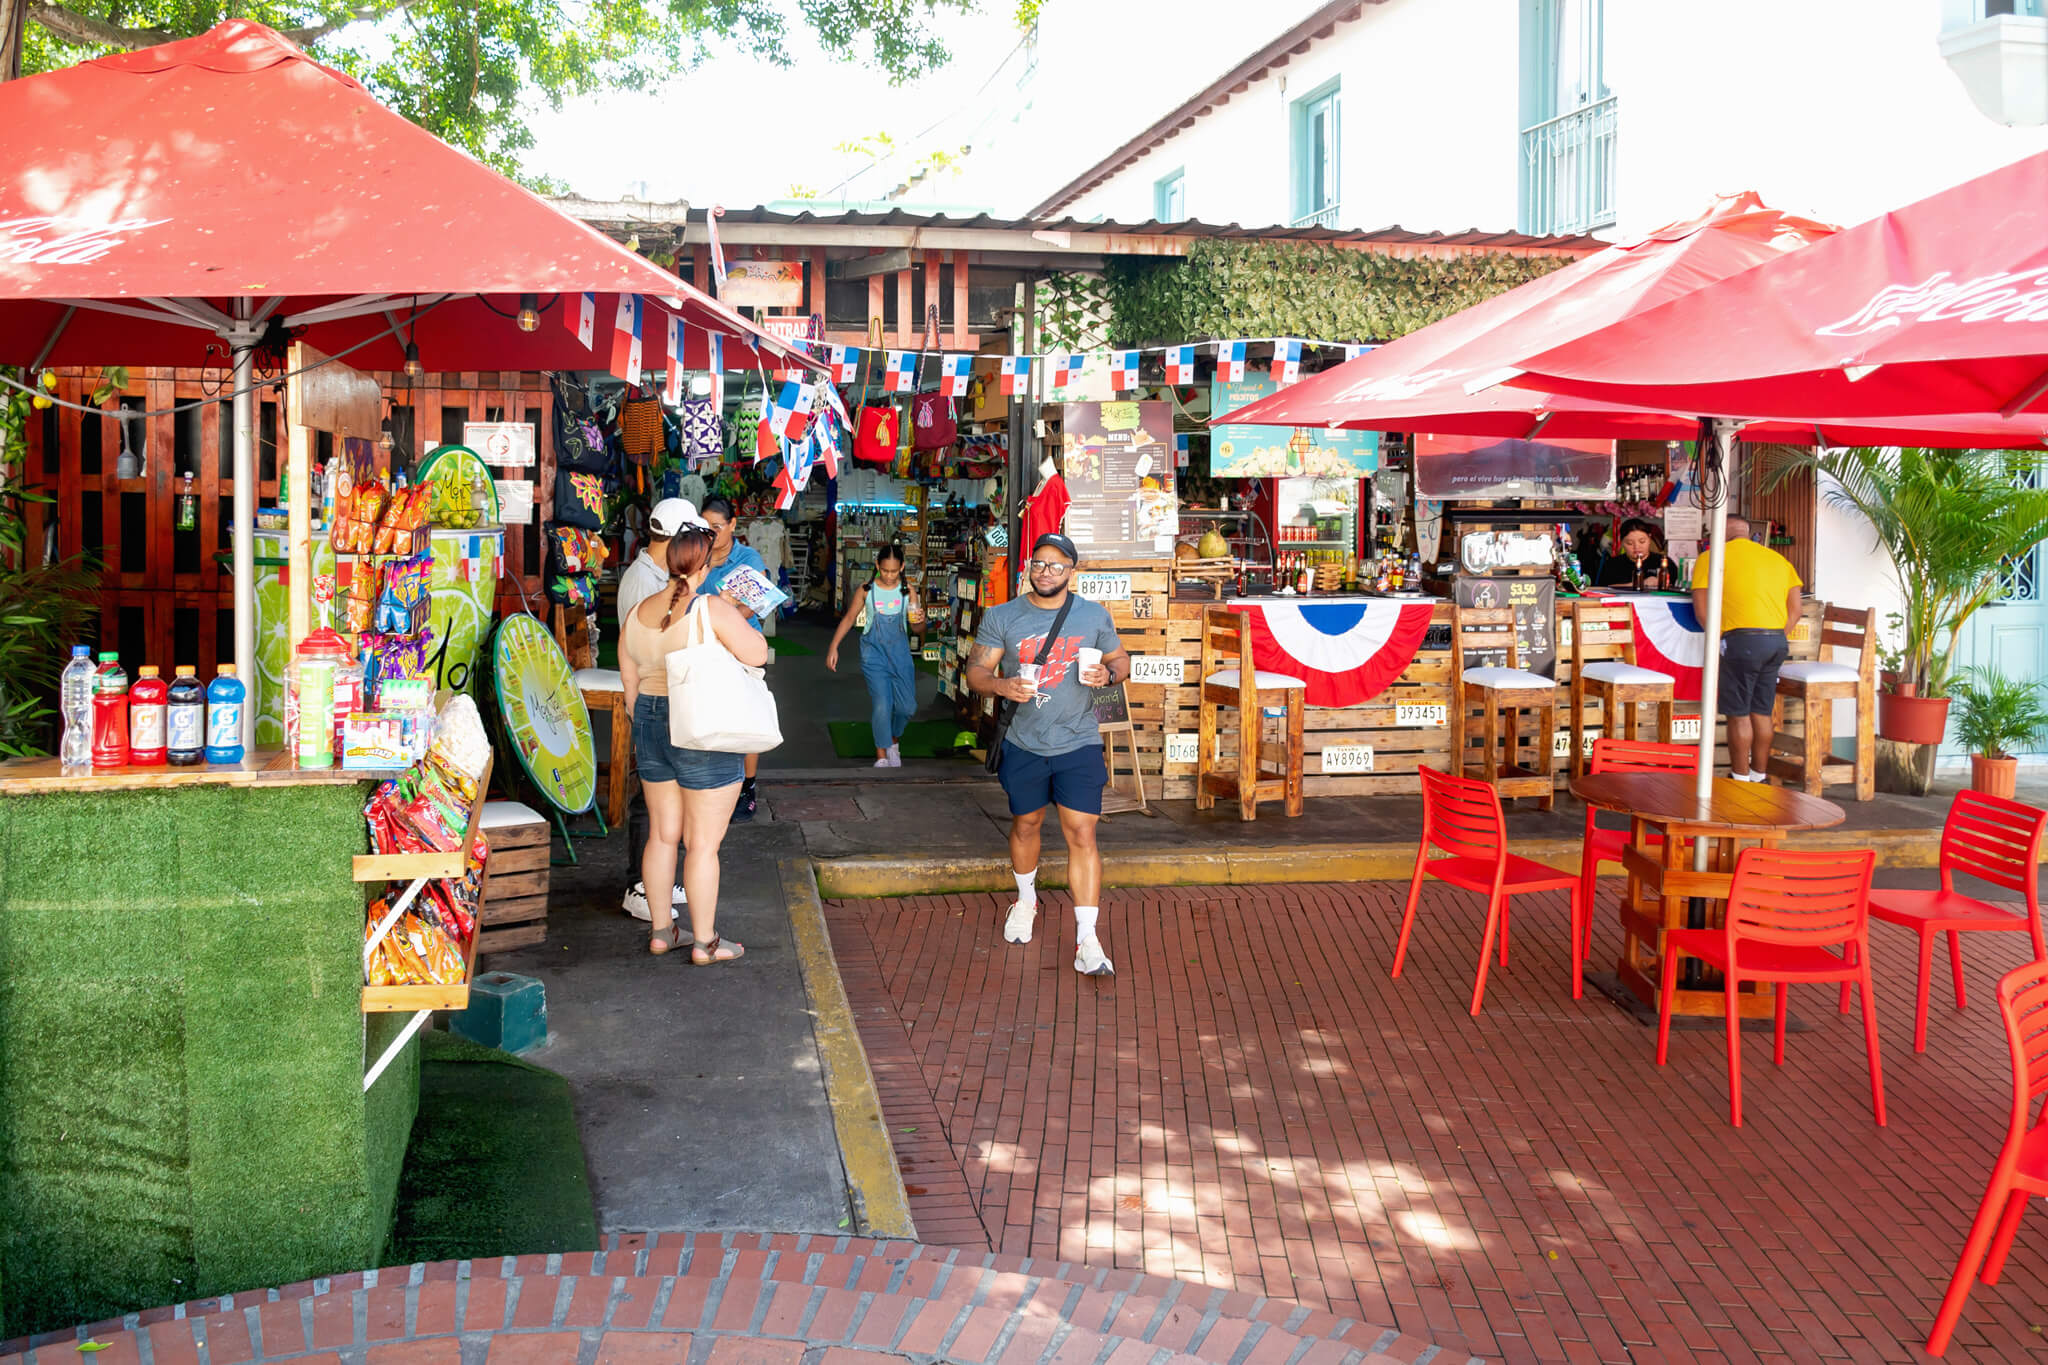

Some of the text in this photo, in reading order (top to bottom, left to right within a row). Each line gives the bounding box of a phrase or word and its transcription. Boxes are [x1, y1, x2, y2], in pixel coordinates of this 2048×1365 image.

[1081, 581, 1128, 594] 887317
[1135, 662, 1180, 676] 024955
[1400, 706, 1442, 719] 393451
[1326, 752, 1370, 767] AY8969
